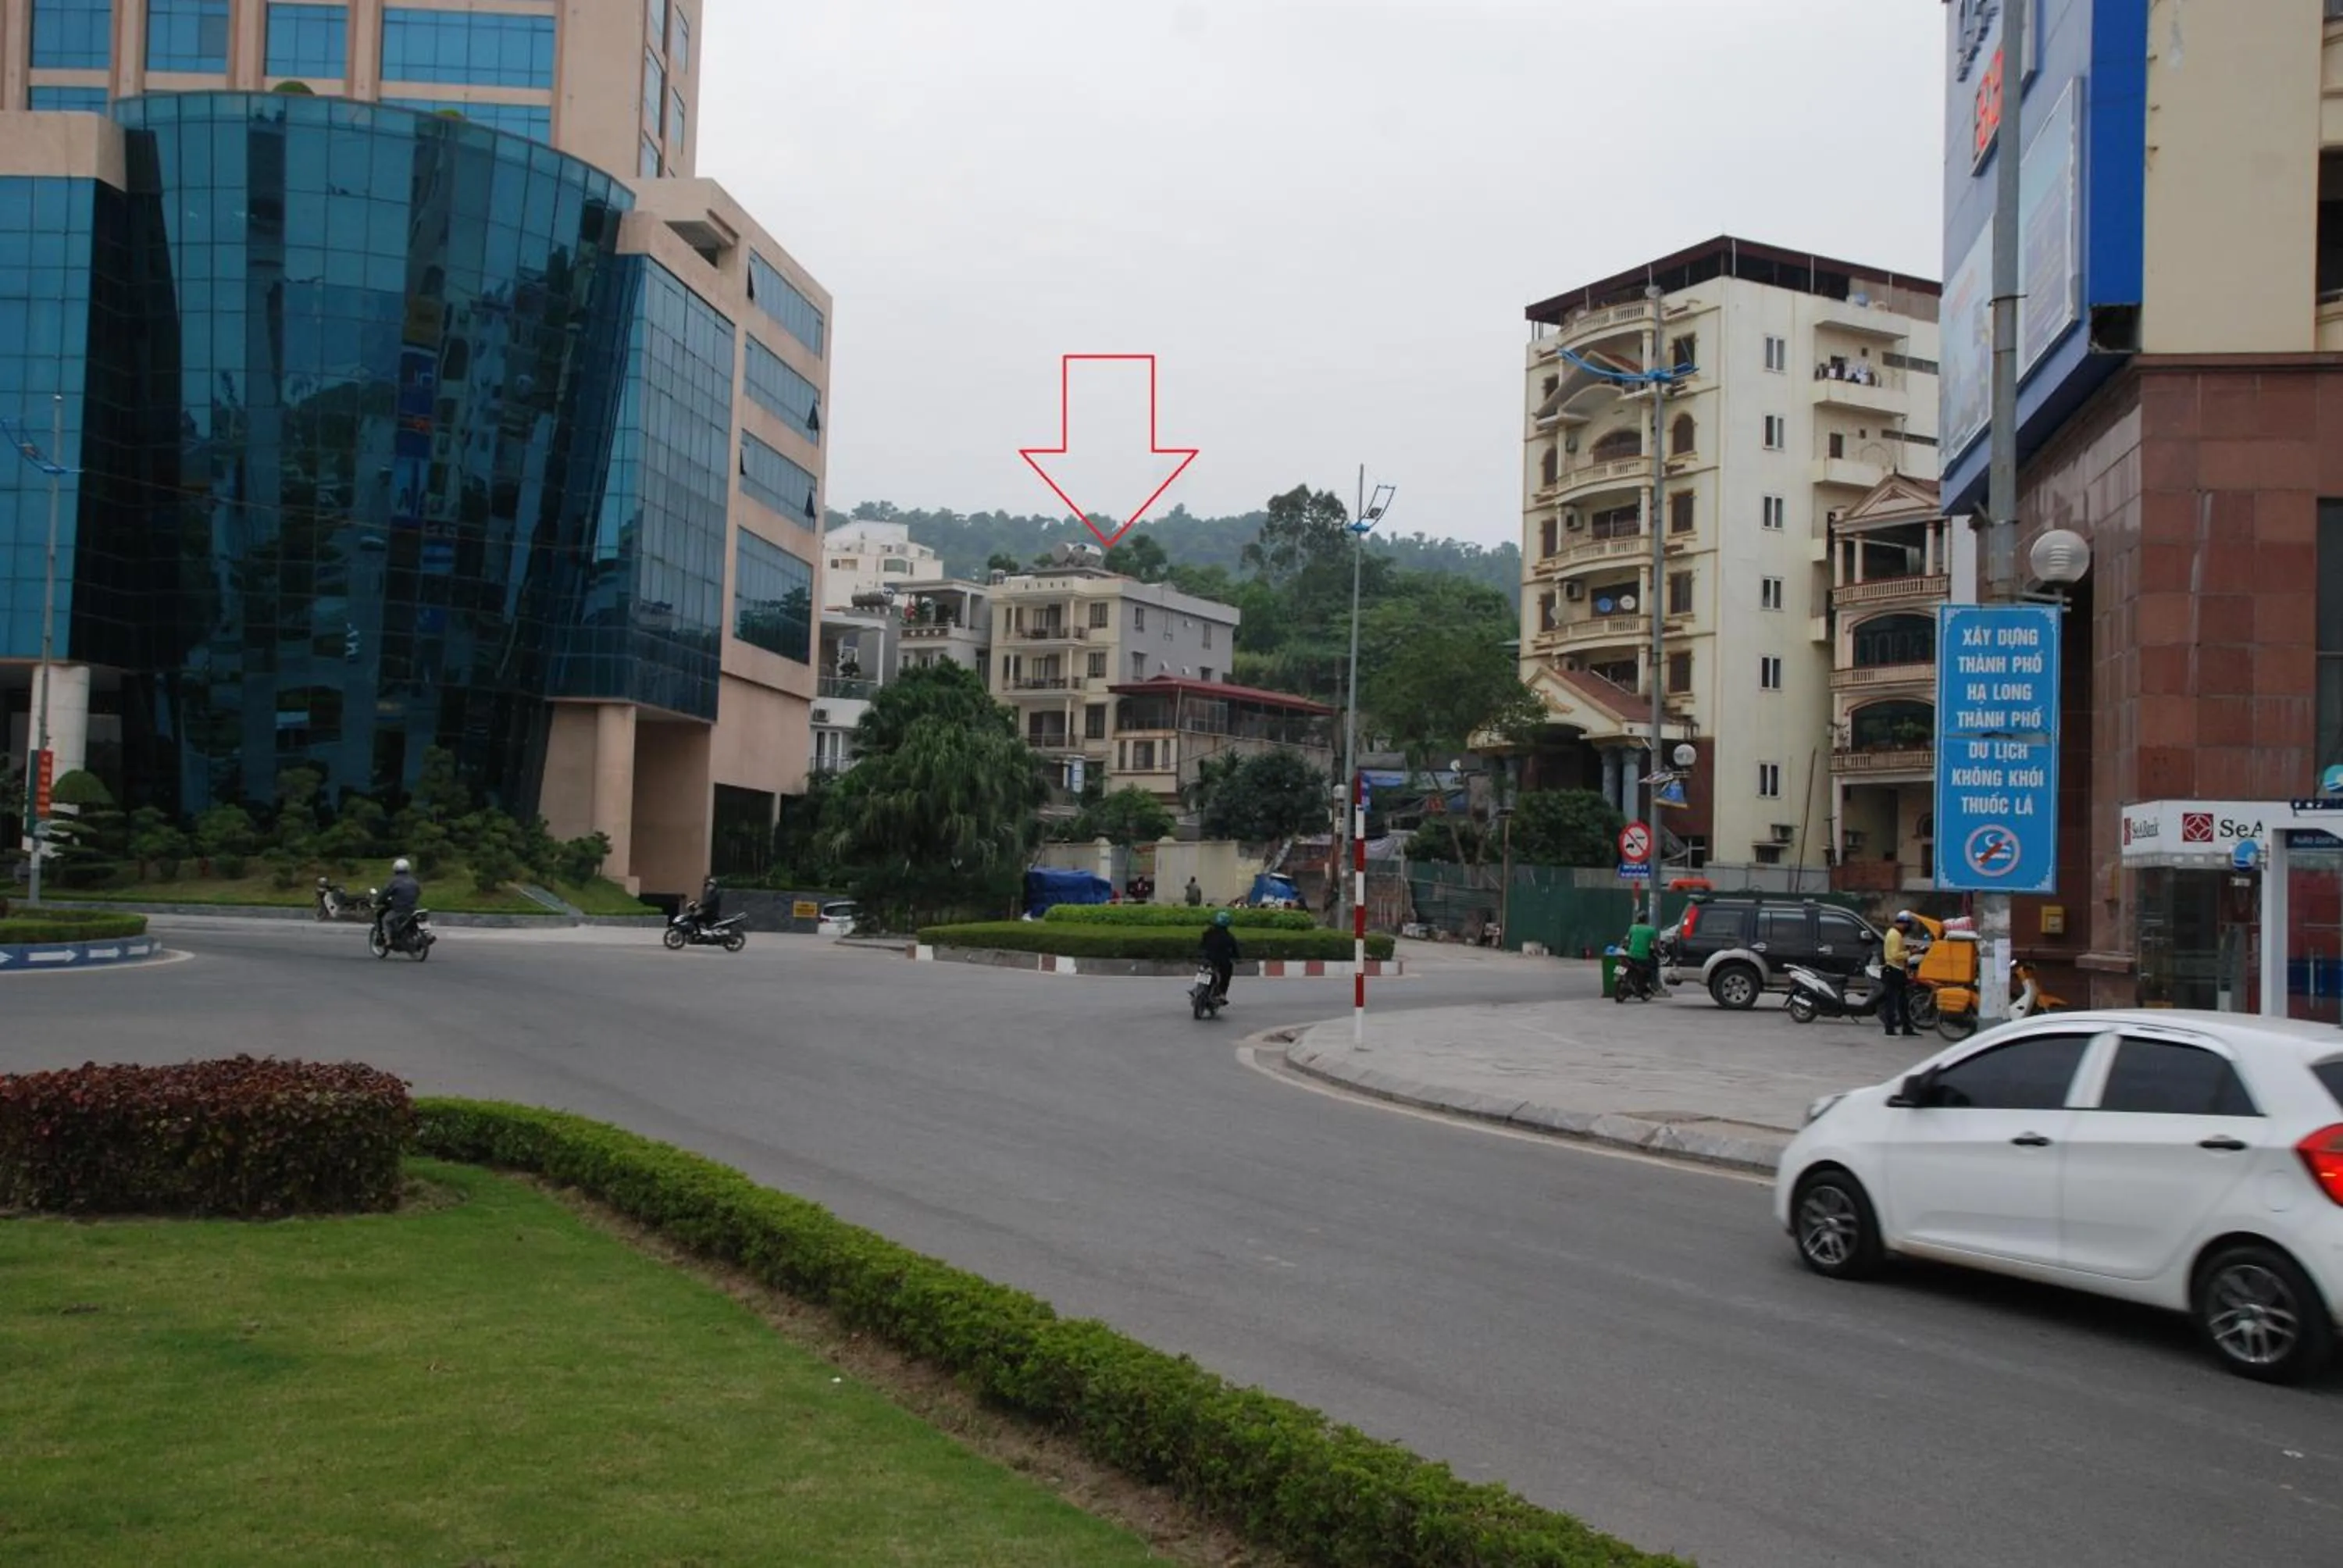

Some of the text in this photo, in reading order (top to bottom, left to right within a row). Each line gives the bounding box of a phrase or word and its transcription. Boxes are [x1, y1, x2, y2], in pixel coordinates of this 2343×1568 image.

[1967, 683, 2032, 705] HẠ LONG
[1969, 742, 2027, 763] DU LỊCH
[1952, 766, 2044, 787] KHÔNG KHÓI
[1961, 792, 2033, 815] THUỐC LÁ
